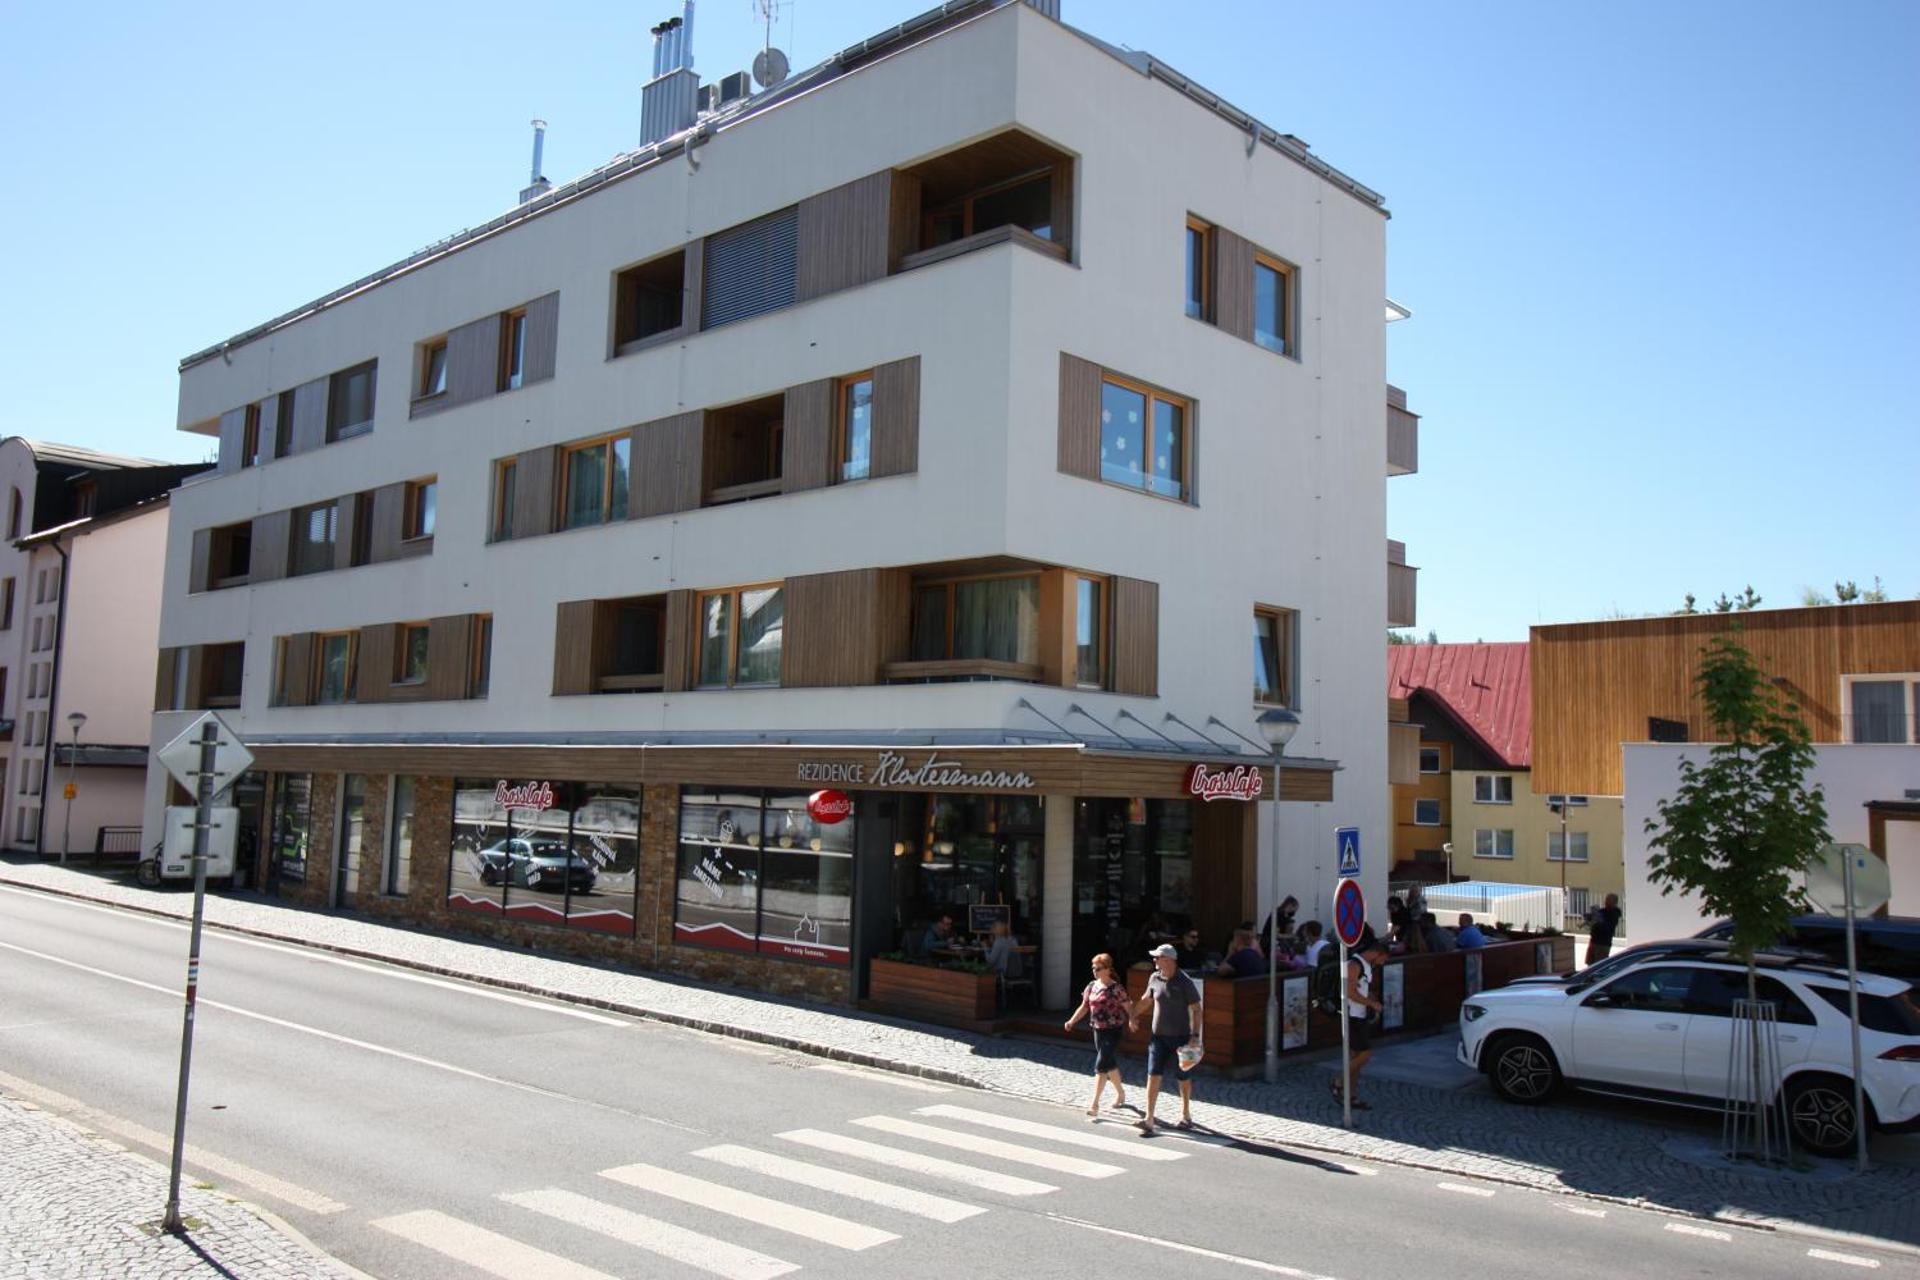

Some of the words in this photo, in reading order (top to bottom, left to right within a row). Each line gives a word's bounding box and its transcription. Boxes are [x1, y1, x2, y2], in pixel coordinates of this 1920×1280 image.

[798, 762, 864, 784] REZIDENCE
[869, 751, 1034, 788] Klostermann
[1191, 764, 1262, 801] CrossCafe
[495, 780, 553, 811] CrossCafe
[693, 865, 724, 898] ZMRZLINU
[702, 857, 722, 881] MÁME
